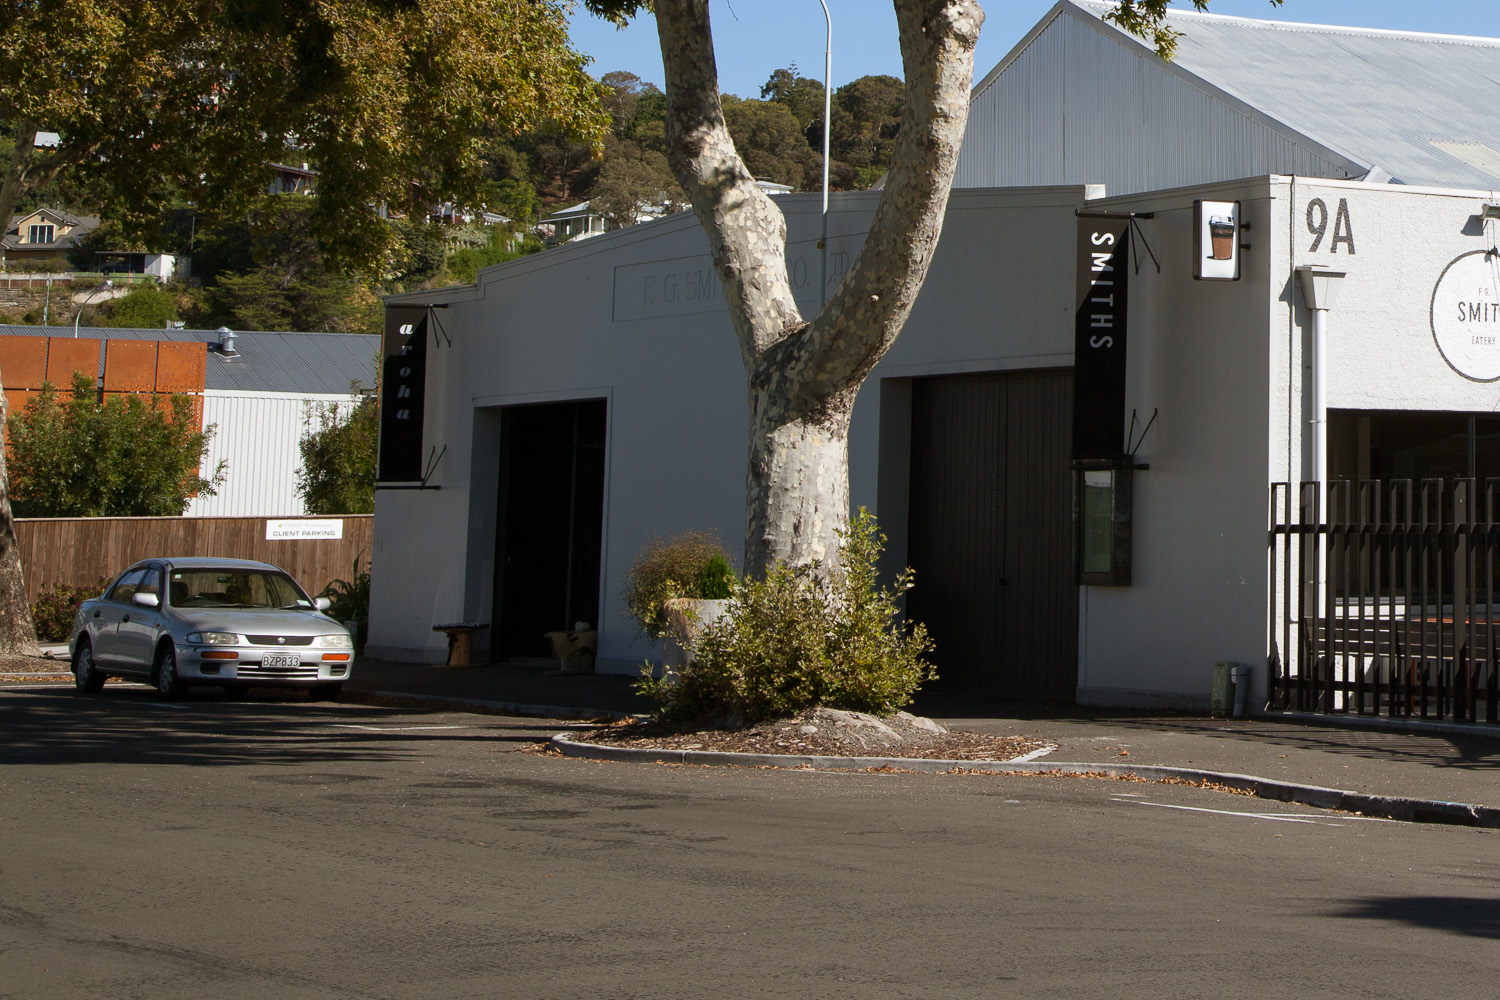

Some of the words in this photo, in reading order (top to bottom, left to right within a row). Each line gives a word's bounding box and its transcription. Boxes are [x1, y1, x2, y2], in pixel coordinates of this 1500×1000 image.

[1306, 197, 1355, 255] 9A
[1089, 231, 1115, 349] SMITHS
[1471, 335, 1496, 346] EATERY
[396, 323, 414, 420] aroha
[263, 656, 299, 667] BZP833
